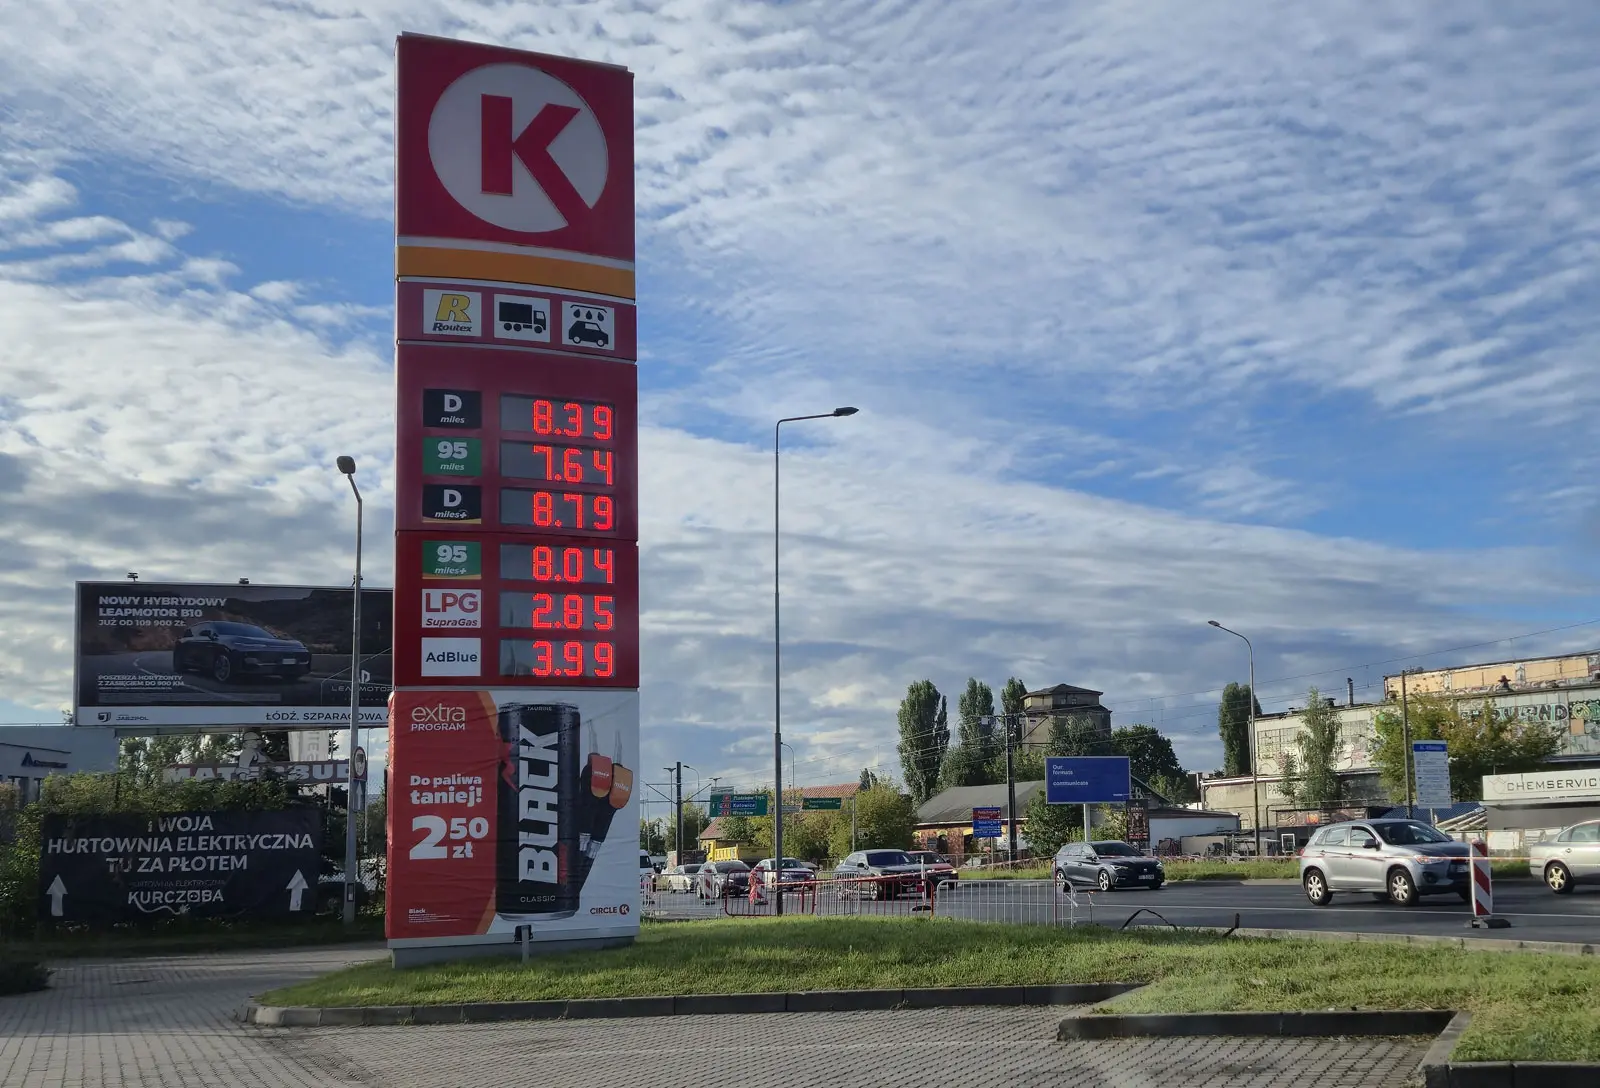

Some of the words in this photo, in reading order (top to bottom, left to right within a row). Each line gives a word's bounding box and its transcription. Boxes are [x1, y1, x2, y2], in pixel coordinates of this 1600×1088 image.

[435, 293, 471, 322] R
[433, 322, 472, 332] Routex
[443, 394, 462, 412] D
[440, 415, 465, 424] miles
[532, 400, 613, 440] 8.39
[437, 441, 467, 459] 95
[440, 462, 465, 471] miles
[532, 445, 613, 485] 7.64
[443, 489, 462, 507] D
[532, 491, 613, 530] 8.79
[437, 545, 467, 563] 95
[532, 545, 613, 584] 8.04
[99, 596, 140, 605] NOWY
[143, 596, 227, 606] HYBRYDOWY
[425, 592, 479, 613] LPG
[99, 607, 178, 617] LEAPMOTOR
[181, 609, 203, 618] B10
[532, 592, 613, 630] 2.85
[425, 618, 478, 628] SupraGas
[425, 651, 478, 663] AdBlue
[532, 640, 613, 677] 3.99
[411, 702, 466, 722] extra
[411, 723, 466, 731] PROGRAM
[410, 775, 431, 787] Do
[433, 773, 482, 788] paliwa
[1507, 777, 1600, 791] CHEMSERVIC
[410, 786, 483, 808] taniej!
[518, 723, 559, 885] BLACK
[48, 837, 173, 854] HURTOWNIA
[176, 833, 314, 852] ELEKTRYCZNA
[409, 815, 448, 860] 2
[449, 817, 489, 840] 50
[452, 841, 473, 859] zł
[137, 857, 164, 873] ZA
[168, 855, 248, 873] PŁOTEM
[127, 889, 225, 905] KURCZOBA
[520, 895, 556, 903] CLASSIC
[589, 906, 618, 915] CIRCLE
